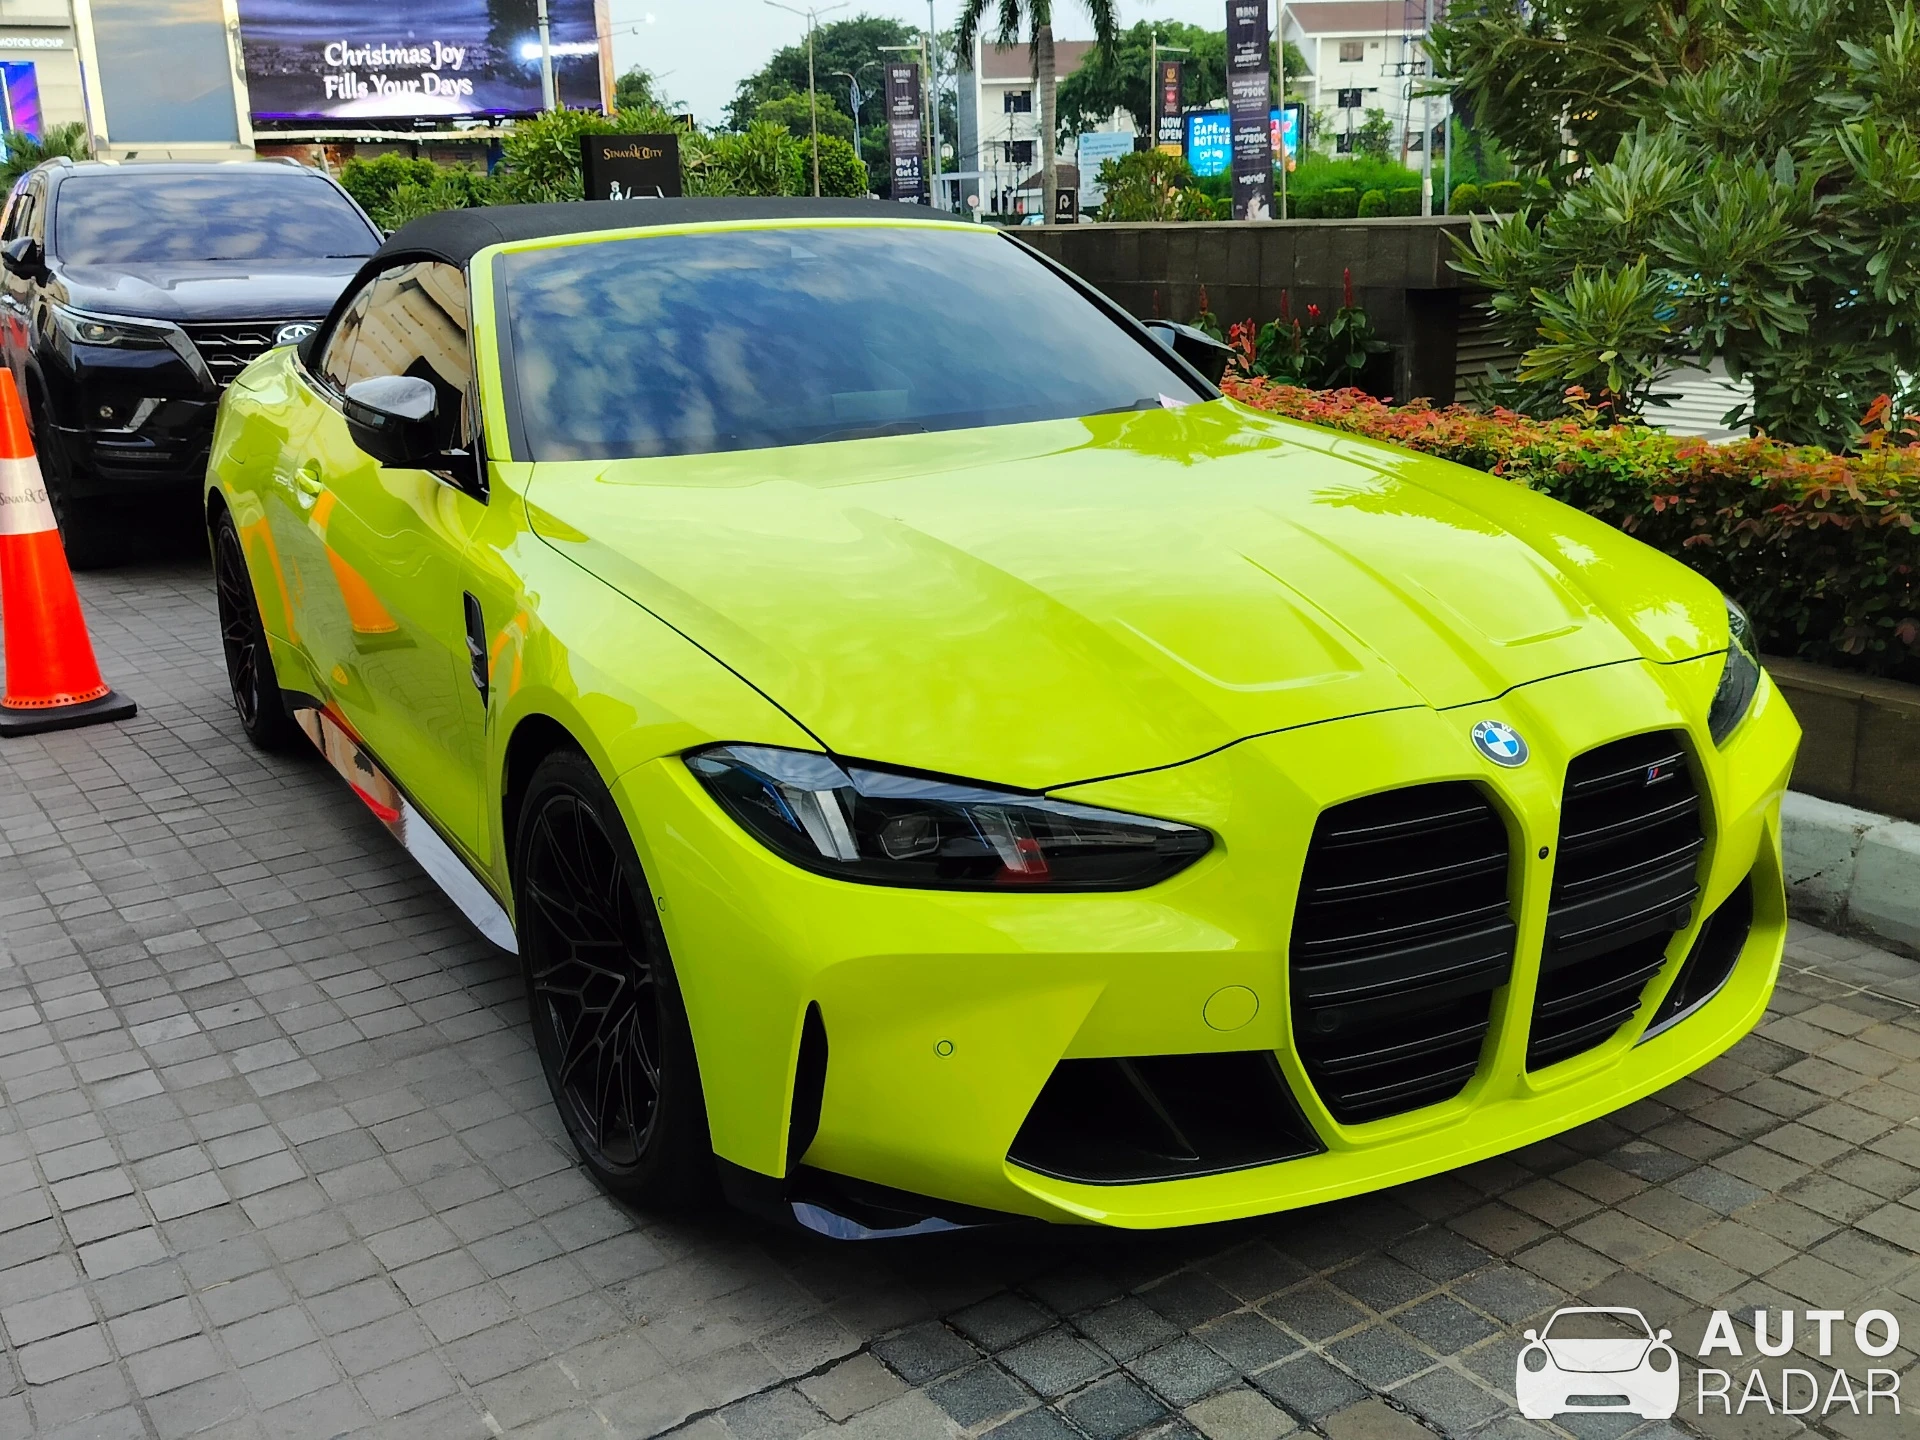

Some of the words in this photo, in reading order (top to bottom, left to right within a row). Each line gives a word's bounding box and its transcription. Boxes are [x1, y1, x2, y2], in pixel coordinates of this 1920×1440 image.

[0, 38, 31, 48] MOTOR
[32, 38, 64, 48] GROUP
[324, 40, 431, 67] Christmas
[430, 40, 465, 71] Joy
[323, 72, 369, 99] Fills
[370, 74, 421, 97] Your
[421, 72, 474, 99] Days
[1160, 117, 1182, 128] NOW
[1159, 129, 1182, 140] OPEN
[895, 157, 912, 168] Buy
[912, 156, 918, 166] 1
[896, 167, 912, 177] Get
[912, 167, 919, 176] 2
[1473, 721, 1512, 739] BMW
